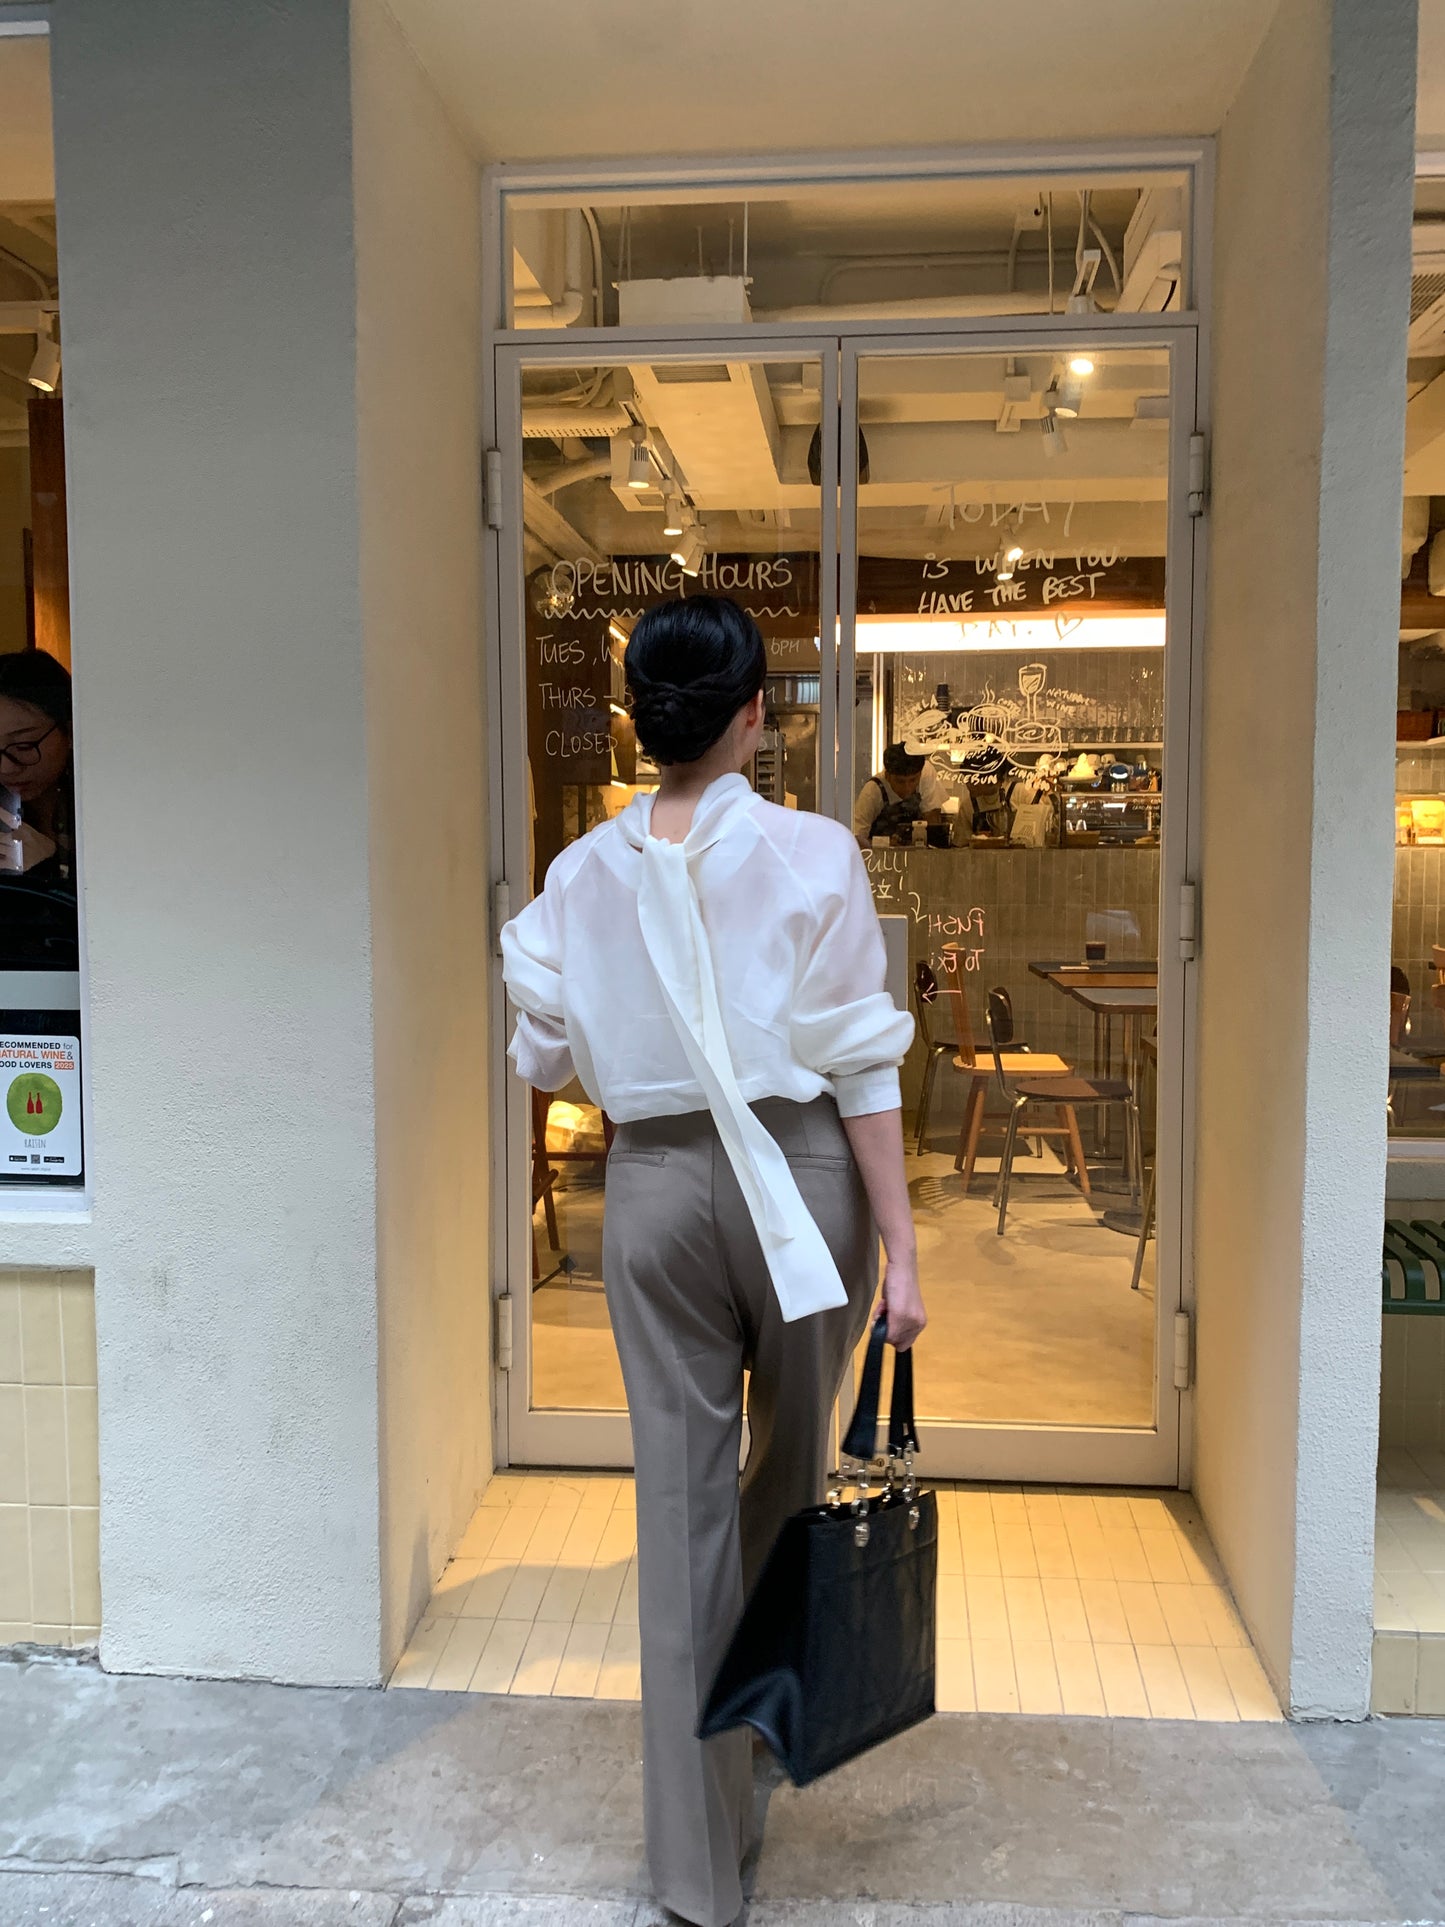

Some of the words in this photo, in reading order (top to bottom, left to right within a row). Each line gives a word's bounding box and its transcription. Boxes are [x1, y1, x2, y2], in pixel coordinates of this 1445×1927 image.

[918, 590, 974, 615] HAVE
[984, 581, 1027, 606] THE
[1042, 571, 1106, 605] BEST
[538, 682, 597, 710] THURS
[545, 730, 618, 758] CLOSED
[0, 1040, 61, 1050] ECOMMENDED
[0, 1060, 17, 1068] OOD
[19, 1061, 53, 1069] LOVERS
[41, 1050, 66, 1060] WINE
[66, 1051, 74, 1061] &
